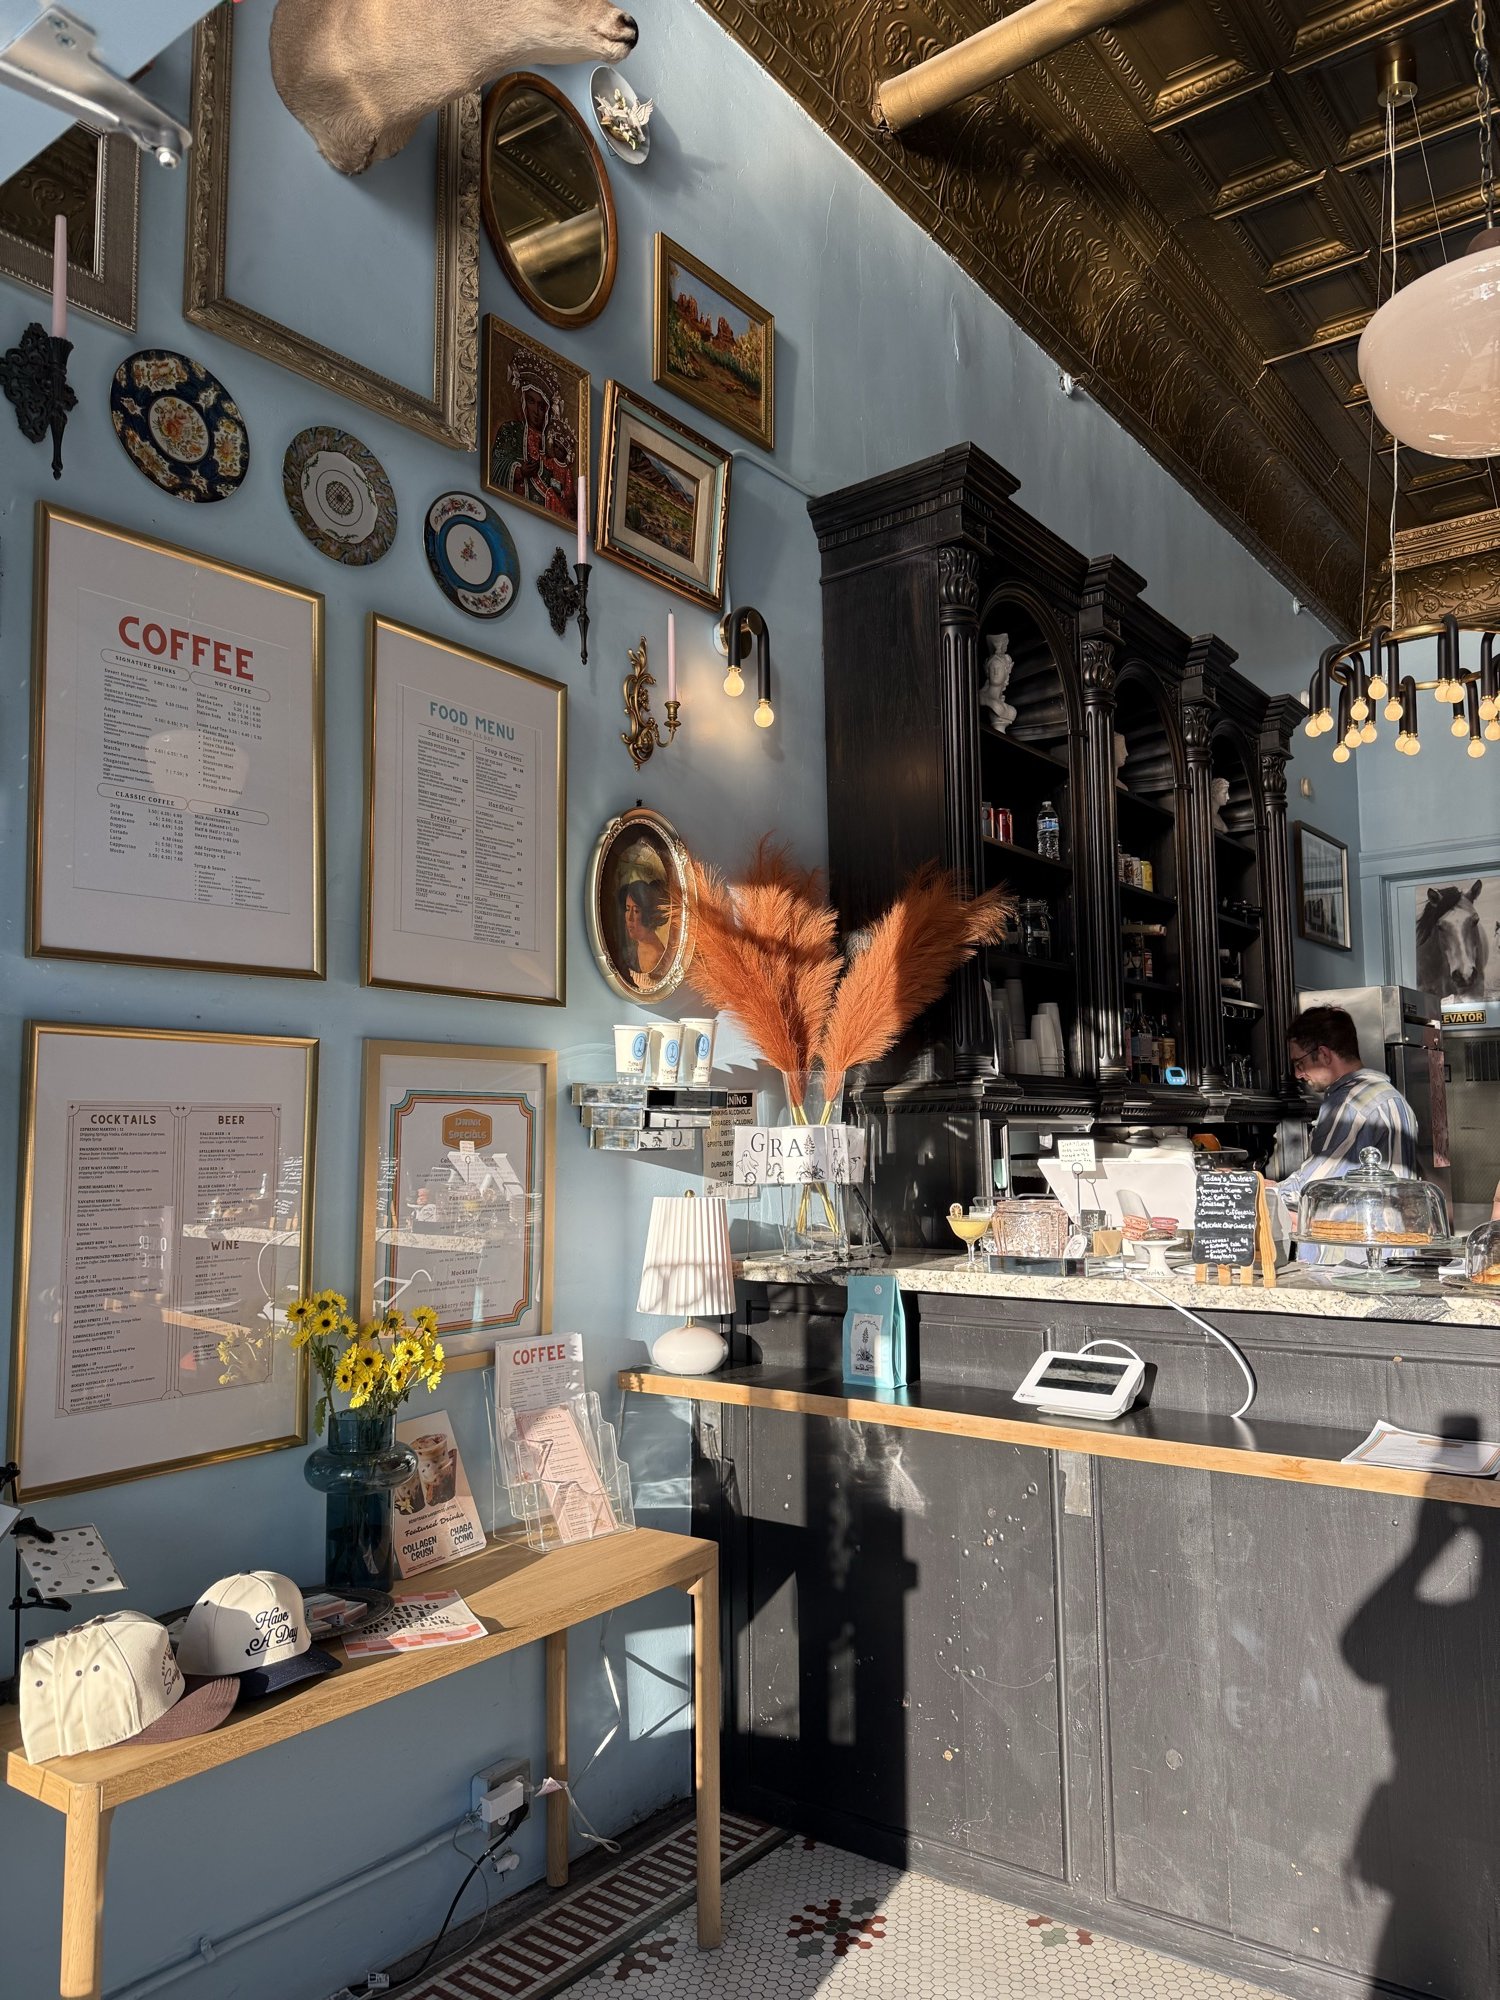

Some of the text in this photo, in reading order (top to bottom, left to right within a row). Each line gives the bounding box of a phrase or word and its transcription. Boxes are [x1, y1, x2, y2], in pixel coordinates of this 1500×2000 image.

[118, 615, 253, 681] COFFEE
[115, 655, 175, 674] SIGNATURE DRINKS
[214, 680, 251, 694] NOT COFFEE
[430, 701, 515, 741] FOOD MENU
[427, 729, 459, 744] Small Bites
[484, 746, 496, 755] Soup
[504, 752, 521, 762] Greens
[115, 790, 174, 806] CLASSIC COFFEE
[214, 807, 239, 816] EXTRAS
[488, 801, 513, 812] Handheld
[430, 813, 456, 824] Breakfast
[489, 890, 510, 899] Desserts
[1442, 1013, 1482, 1023] EVATOR
[728, 1094, 747, 1105] NING
[90, 1114, 156, 1124] COCKTAILS
[218, 1115, 244, 1124] BEER
[455, 1118, 481, 1127] DRINK
[448, 1130, 487, 1140] SPECIALS
[1201, 1174, 1227, 1183] Today's
[211, 1240, 239, 1250] WINE
[451, 1268, 478, 1276] Mocktails
[513, 1344, 566, 1366] COFFEE
[535, 1413, 562, 1423] COCKTAILS
[404, 1520, 438, 1536] Featured
[440, 1512, 466, 1524] Drinks
[450, 1522, 473, 1537] CHAGA
[402, 1536, 436, 1554] COLLAGEN
[454, 1532, 474, 1546] CCINO
[411, 1546, 434, 1562] CRUSH
[256, 1607, 288, 1630] Have
[250, 1625, 298, 1651] A Day
